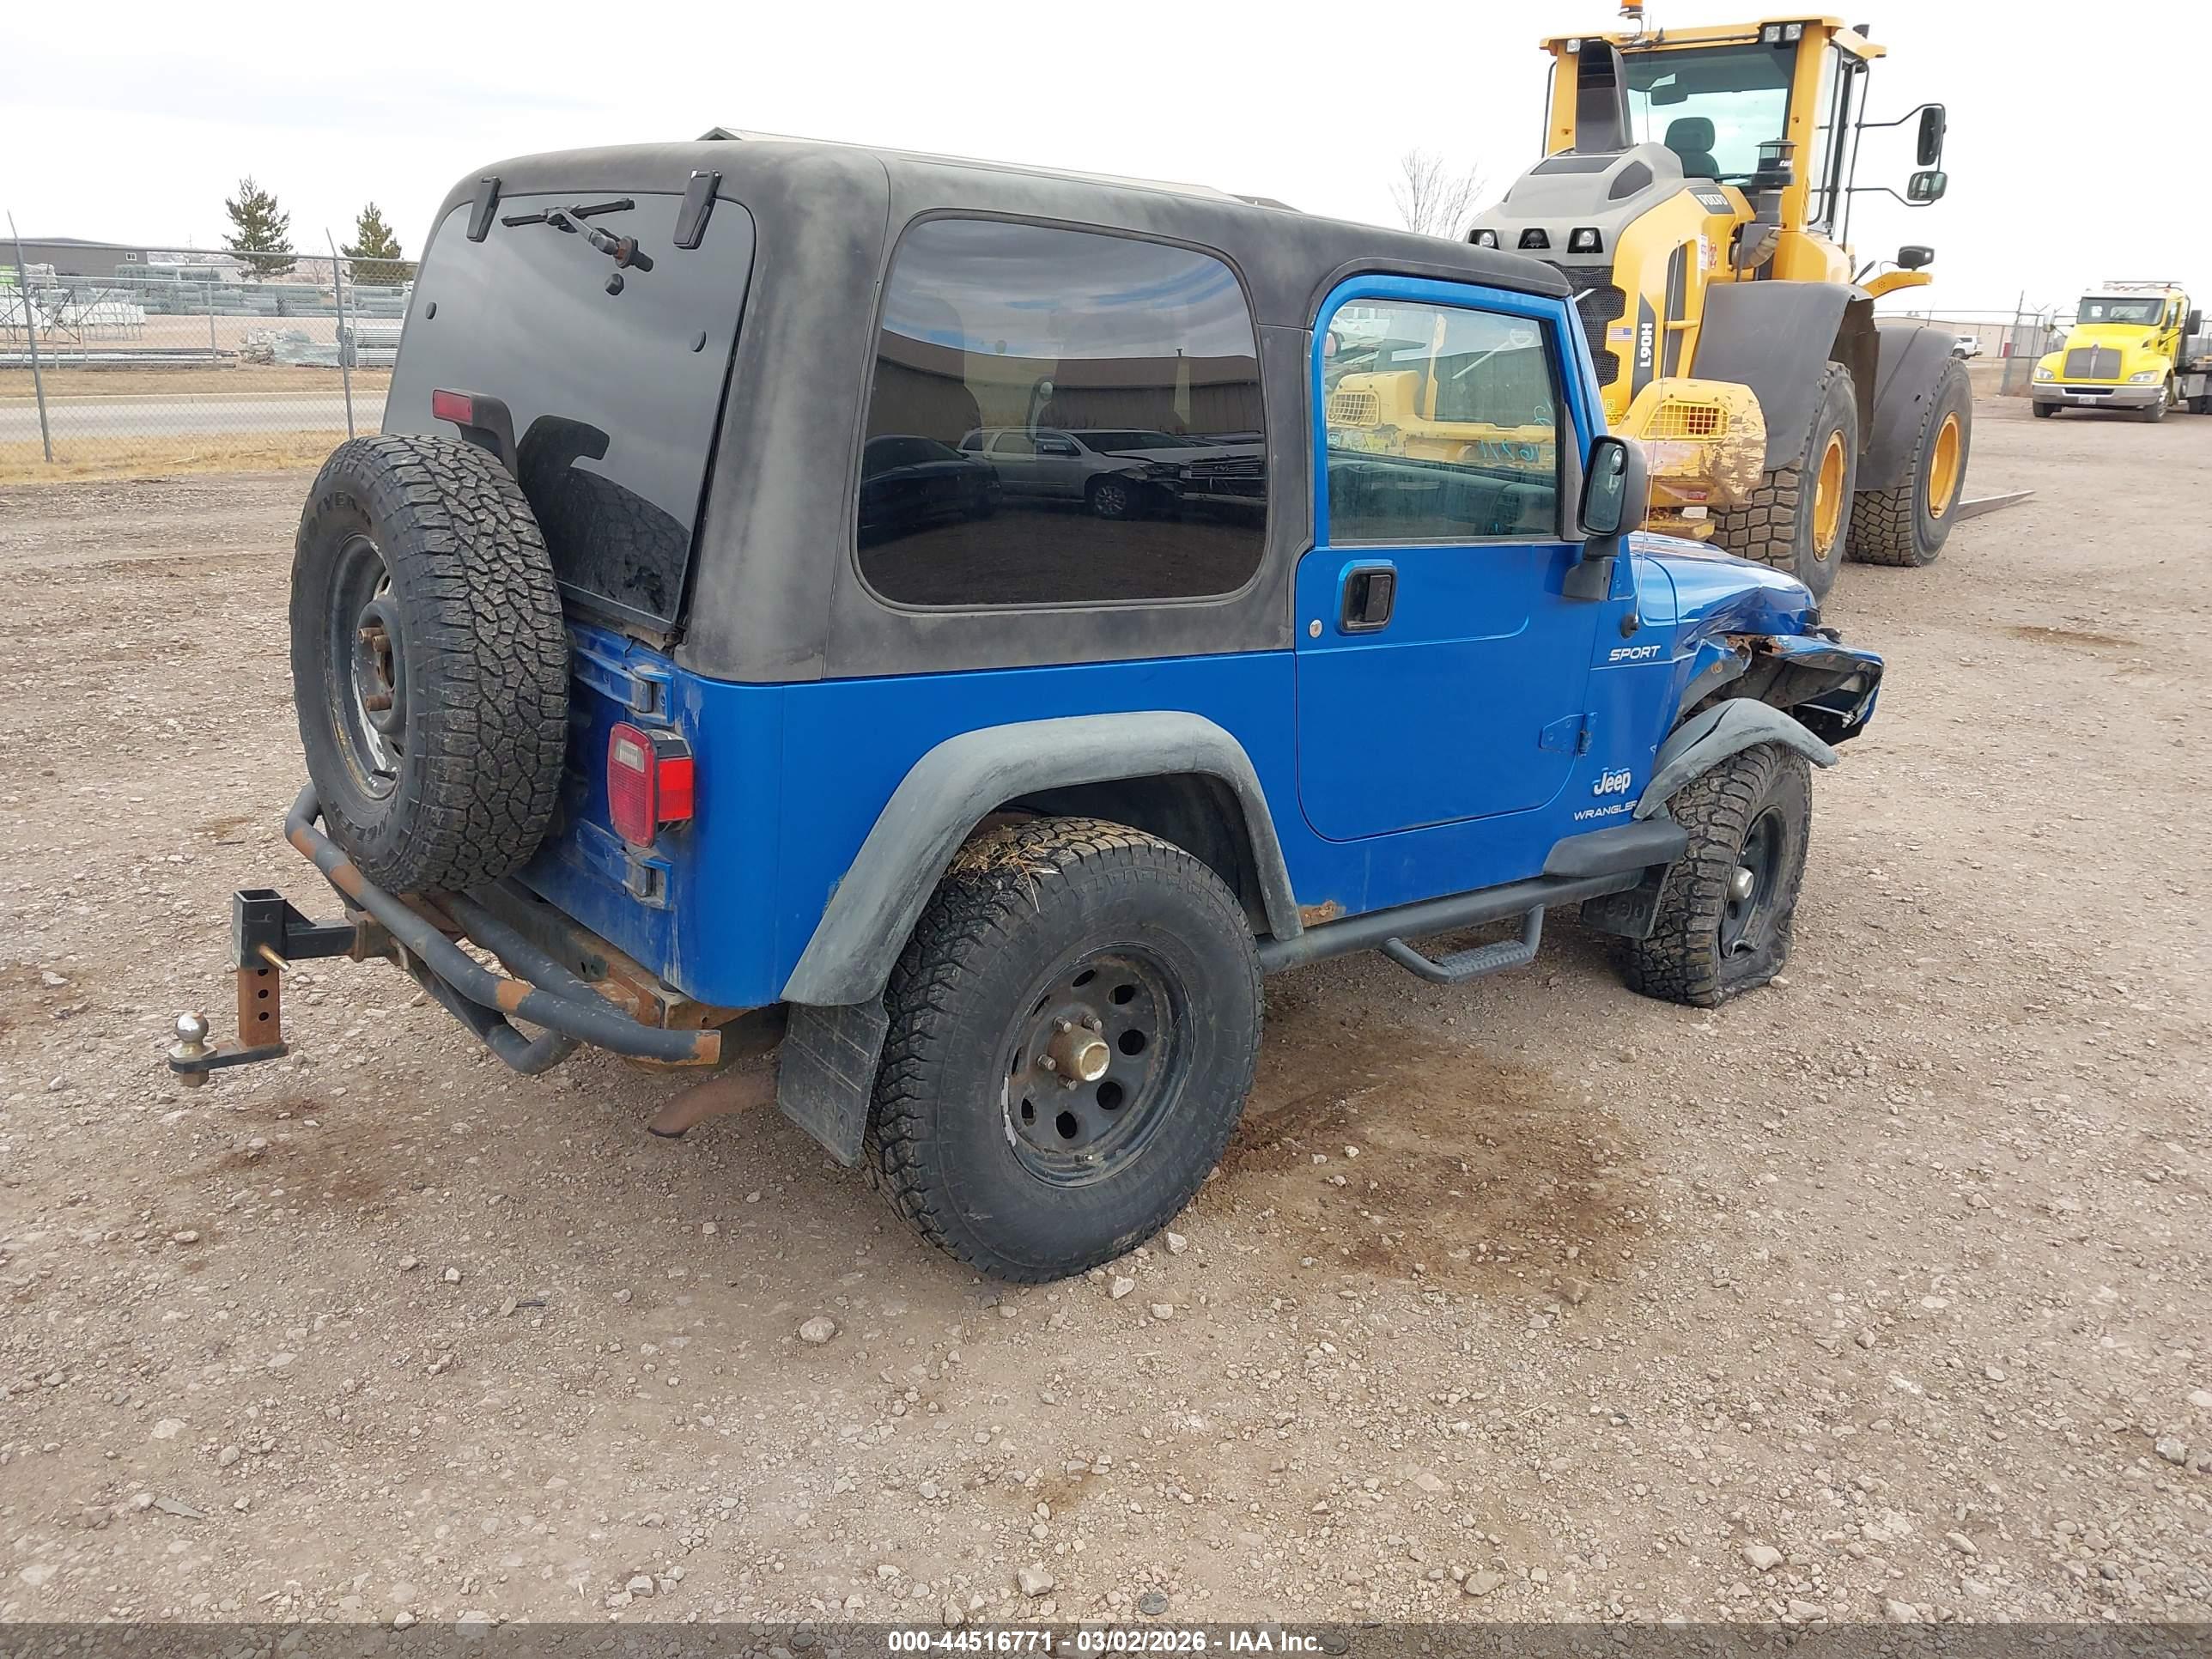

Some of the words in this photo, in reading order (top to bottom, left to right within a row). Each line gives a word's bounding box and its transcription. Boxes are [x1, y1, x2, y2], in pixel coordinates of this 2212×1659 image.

[1695, 194, 1729, 206] VOLVO
[1639, 323, 1653, 368] L90H
[1608, 645, 1662, 661] SPORT
[1592, 767, 1632, 795] Jeep
[1573, 799, 1638, 821] WRANGLER
